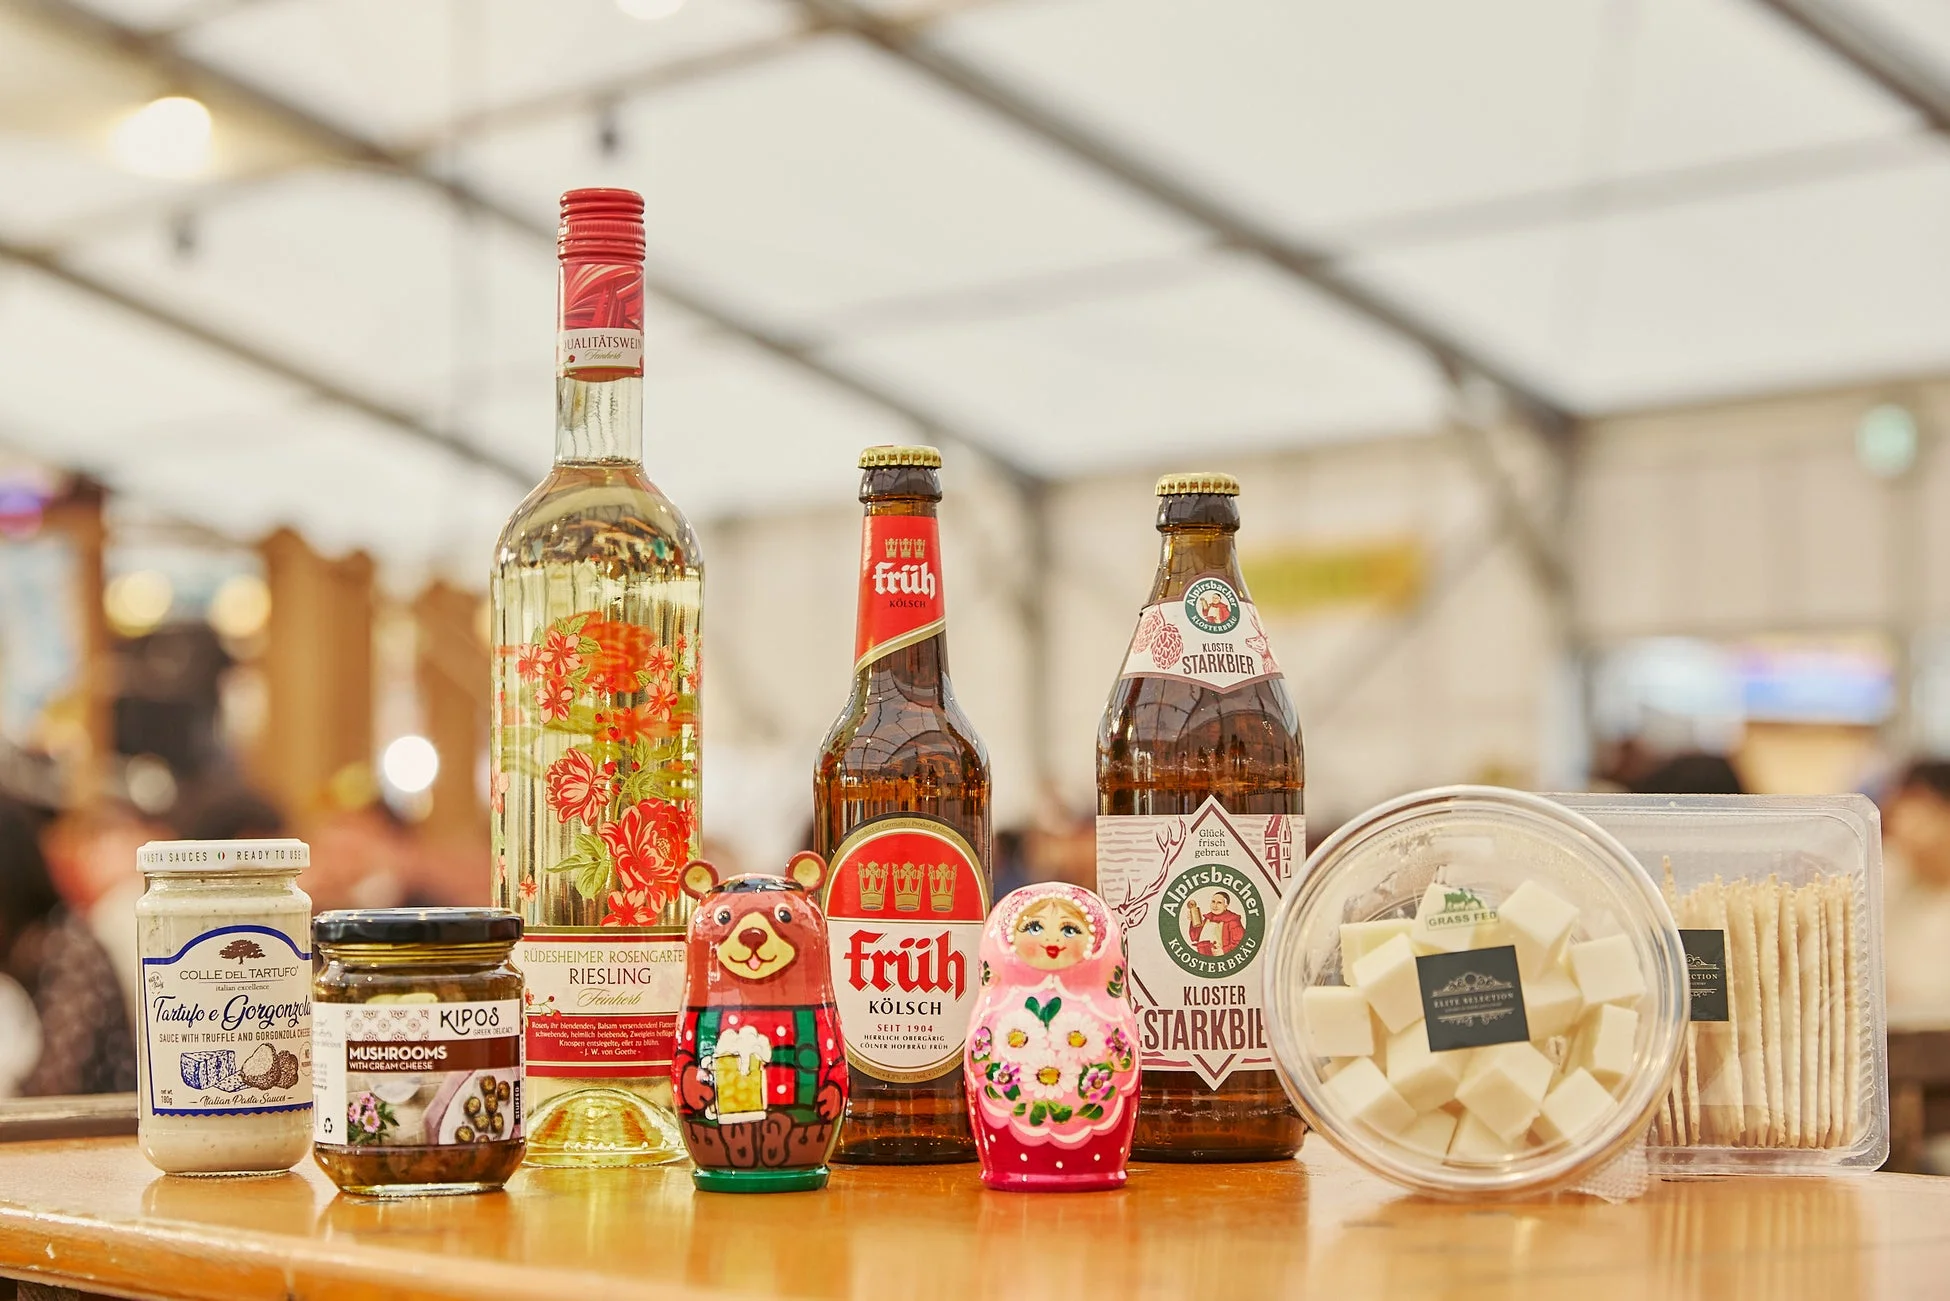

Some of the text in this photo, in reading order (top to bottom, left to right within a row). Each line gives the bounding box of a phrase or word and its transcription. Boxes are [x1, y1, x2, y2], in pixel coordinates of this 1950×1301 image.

[1186, 580, 1238, 607] Alpirsbacher
[889, 597, 926, 608] KÖLSCH
[1191, 615, 1238, 632] KLOSTERBRÄU
[1202, 642, 1235, 653] KLOSTER
[1181, 653, 1256, 675] STARKBIER
[1198, 828, 1225, 839] Glück
[1198, 838, 1226, 848] frisch
[168, 851, 208, 863] SAUCES
[236, 850, 270, 861] READY
[275, 850, 285, 860] TO
[289, 850, 301, 860] USE
[1194, 848, 1230, 859] gebraut
[1162, 866, 1260, 918] Alpirsbacher
[1428, 911, 1497, 927] GRASS FED
[524, 948, 604, 964] RÜDESHEIMER
[1168, 937, 1257, 973] KLOSTERBRÄU
[180, 969, 223, 981] COLLE
[225, 970, 247, 980] DEL
[569, 967, 651, 985] RIESLING
[1688, 973, 1719, 981] CTION
[237, 984, 270, 992] excellence
[1183, 985, 1246, 1006] KLOSTER
[153, 994, 311, 1031] Tartufo e Gorgonzola
[869, 998, 942, 1015] KÖLSCH
[877, 1024, 933, 1033] SEIT 1904
[1144, 1008, 1268, 1051] STARKBIE
[159, 1033, 179, 1043] SAUCE
[181, 1032, 199, 1042] WITH
[202, 1031, 235, 1042] TRUFFLE
[237, 1031, 253, 1042] AND
[255, 1029, 297, 1041] GORGONZOLA
[559, 1039, 585, 1047] Knospen
[902, 1034, 945, 1042] OBERGÄRIG
[349, 1045, 448, 1061] MUSHROOMS
[614, 1048, 637, 1056] Goethe
[349, 1061, 433, 1071] WITH CREAM CHEESE
[199, 1092, 286, 1107] Italian Pasta Sauces
